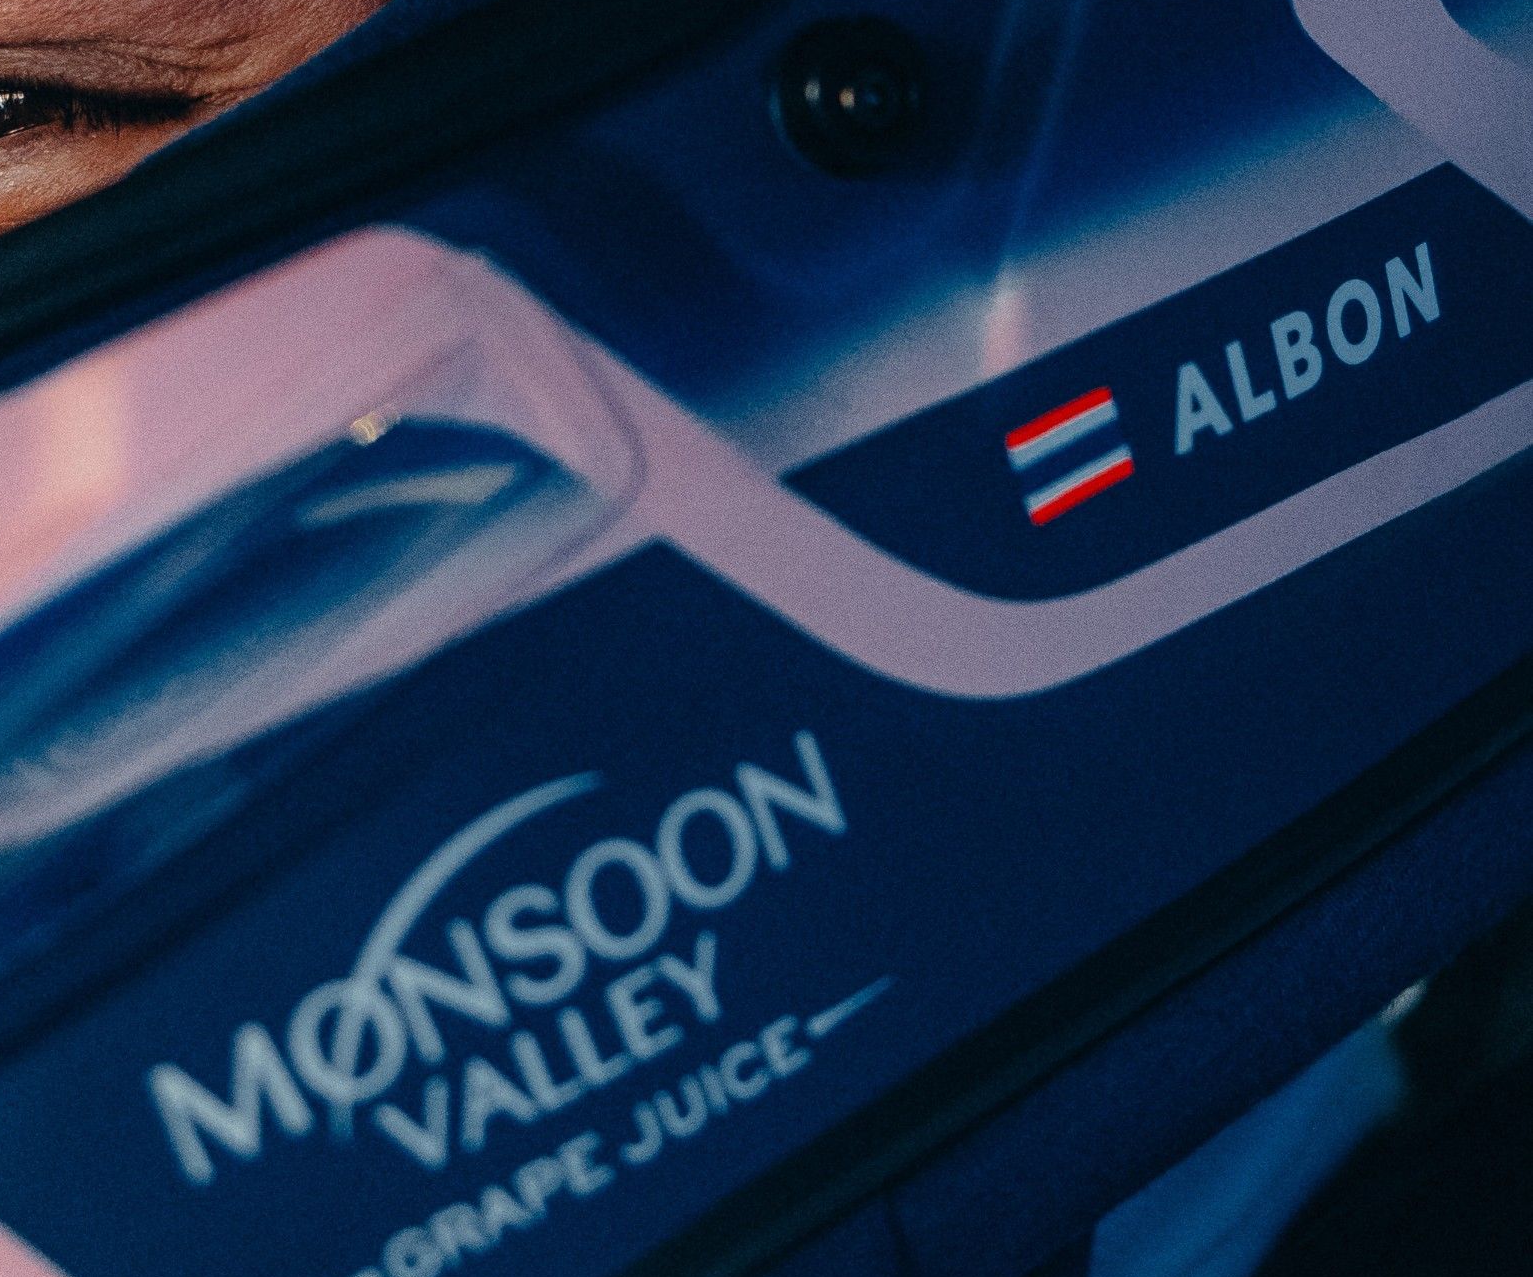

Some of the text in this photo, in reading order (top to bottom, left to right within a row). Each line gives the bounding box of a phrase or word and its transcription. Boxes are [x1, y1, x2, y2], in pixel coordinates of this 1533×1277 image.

[1174, 242, 1441, 456] ALBON
[148, 729, 847, 1184] MONSOON
[377, 931, 721, 1169] VALLEY
[622, 1014, 810, 1165] JUICE
